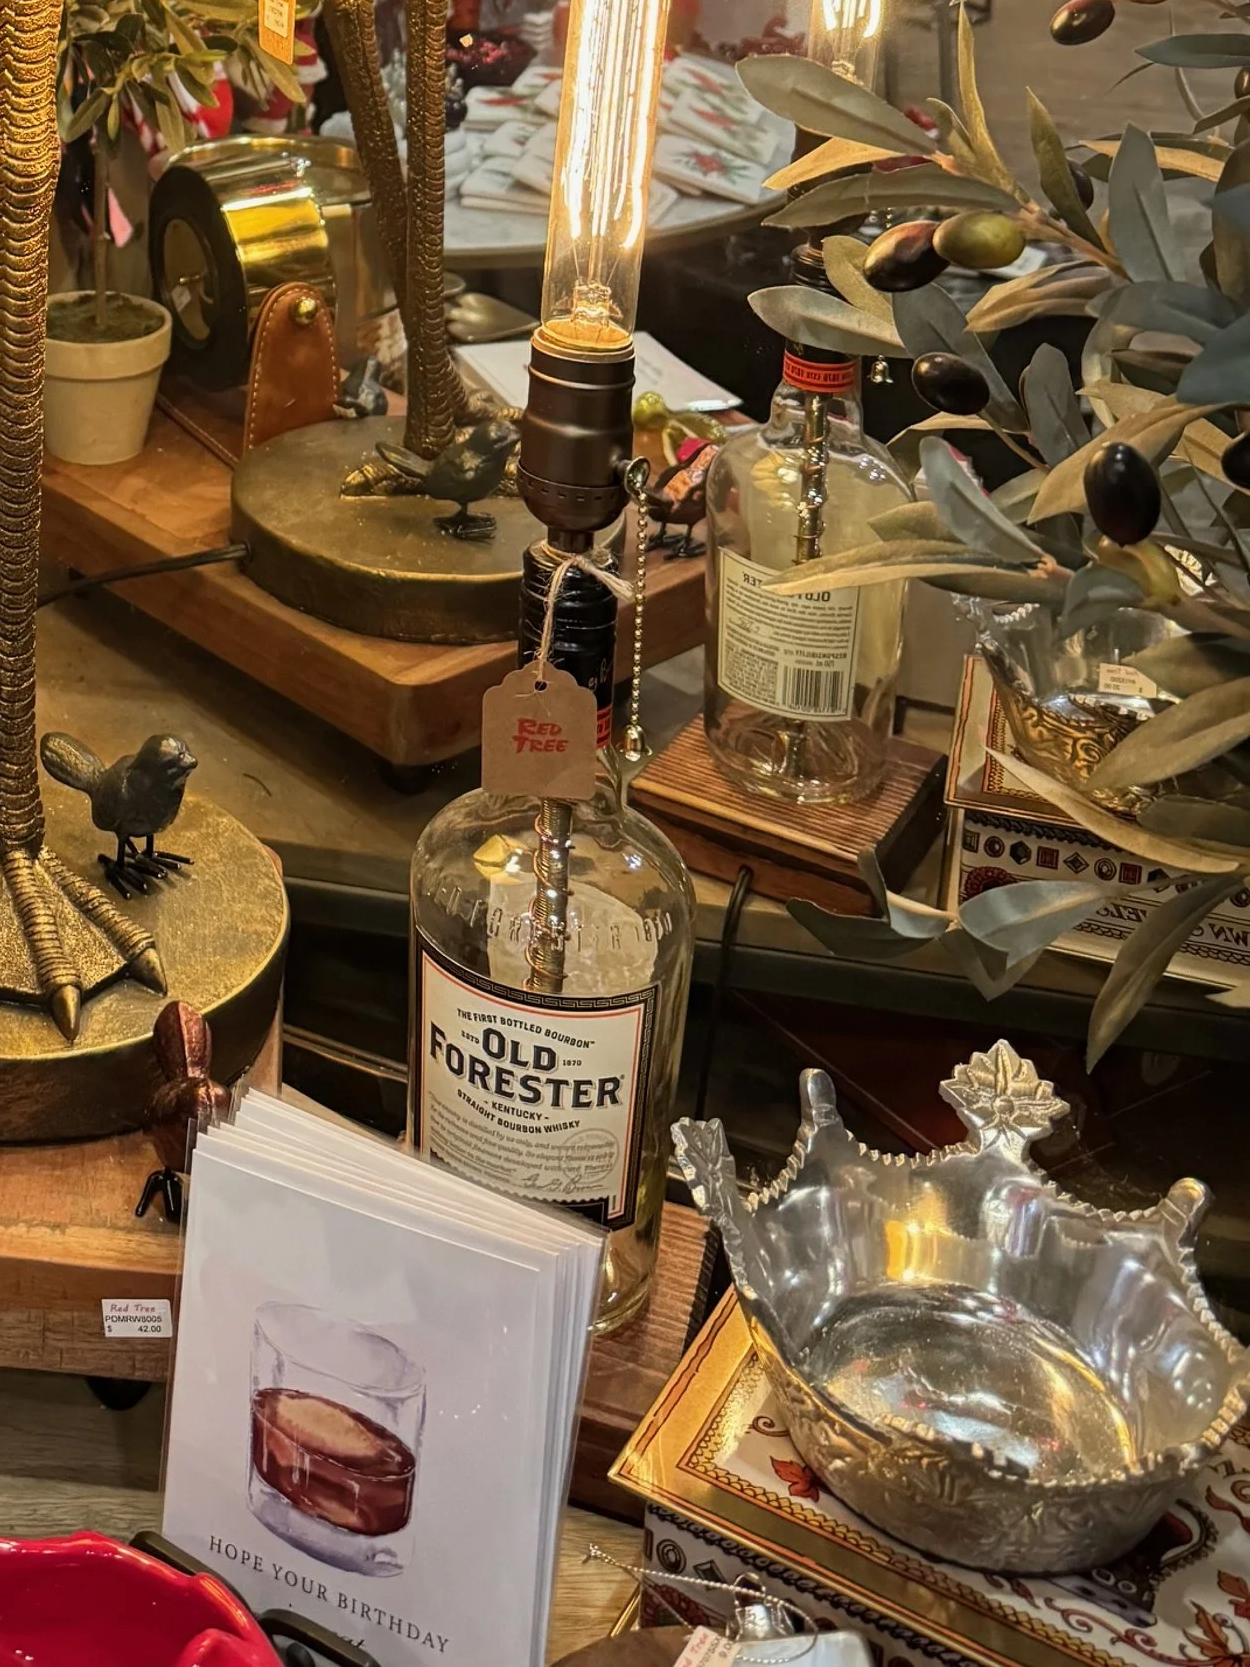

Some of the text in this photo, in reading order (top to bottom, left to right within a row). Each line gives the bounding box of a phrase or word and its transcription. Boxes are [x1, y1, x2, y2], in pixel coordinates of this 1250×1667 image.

[517, 717, 562, 735] RED
[512, 735, 569, 754] TREE
[456, 1008, 472, 1021] THE
[473, 1012, 497, 1024] FIRST
[500, 1016, 542, 1035] BOTTLED
[482, 1027, 558, 1072] OLD
[429, 1020, 622, 1109] FORESTER
[457, 1089, 496, 1122] STRAIGHT
[497, 1118, 542, 1135] BOURBON
[544, 1119, 581, 1134] WHISKY
[492, 1100, 543, 1122] KENTUCKY
[110, 1304, 156, 1313] Red Tree
[107, 1325, 162, 1333] $ 42.00
[209, 1535, 263, 1572] HOPE
[272, 1563, 328, 1602] YOUR
[338, 1592, 449, 1653] BIRTHDAY
